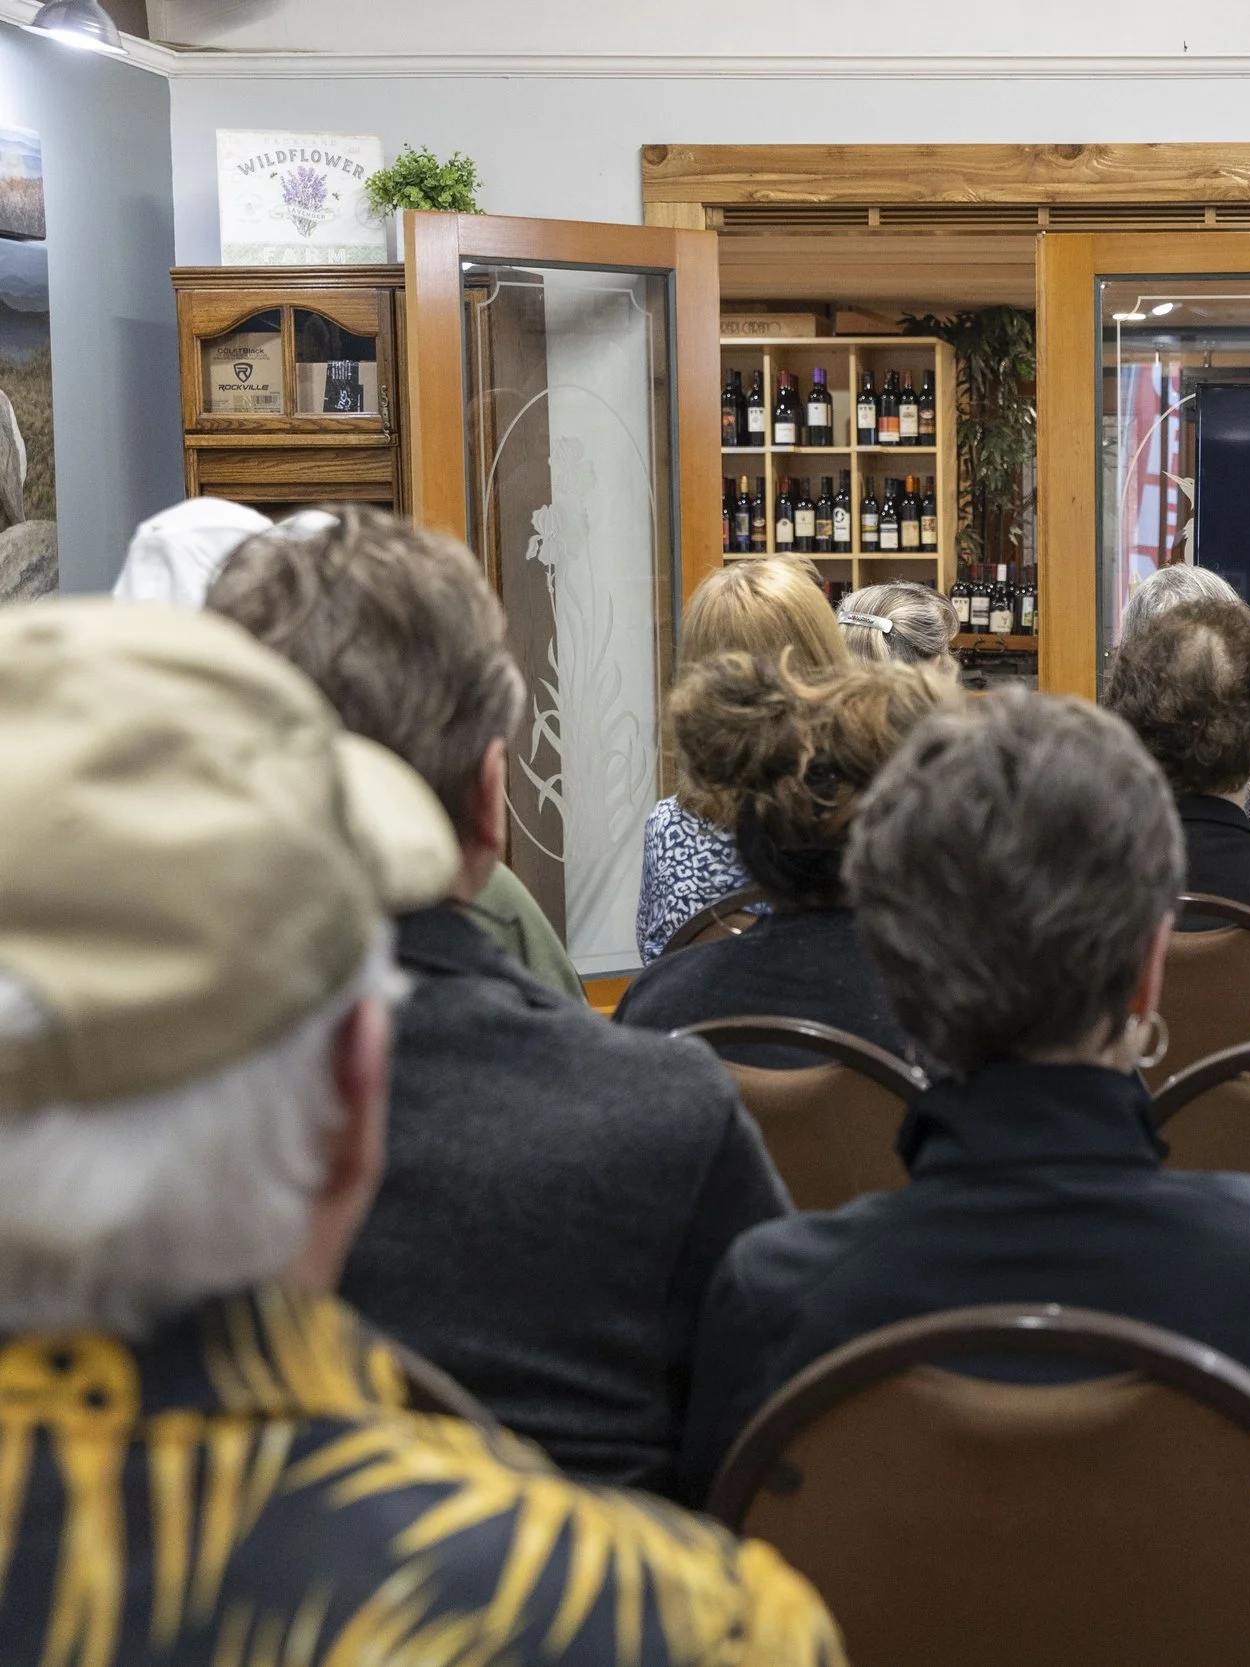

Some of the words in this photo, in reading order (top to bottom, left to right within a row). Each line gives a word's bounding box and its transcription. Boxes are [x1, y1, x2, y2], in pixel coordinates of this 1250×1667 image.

[236, 148, 366, 181] WILDFLOWER
[286, 207, 327, 221] LAVENDER
[263, 248, 346, 263] FARM
[218, 384, 270, 392] ROCKVILLE
